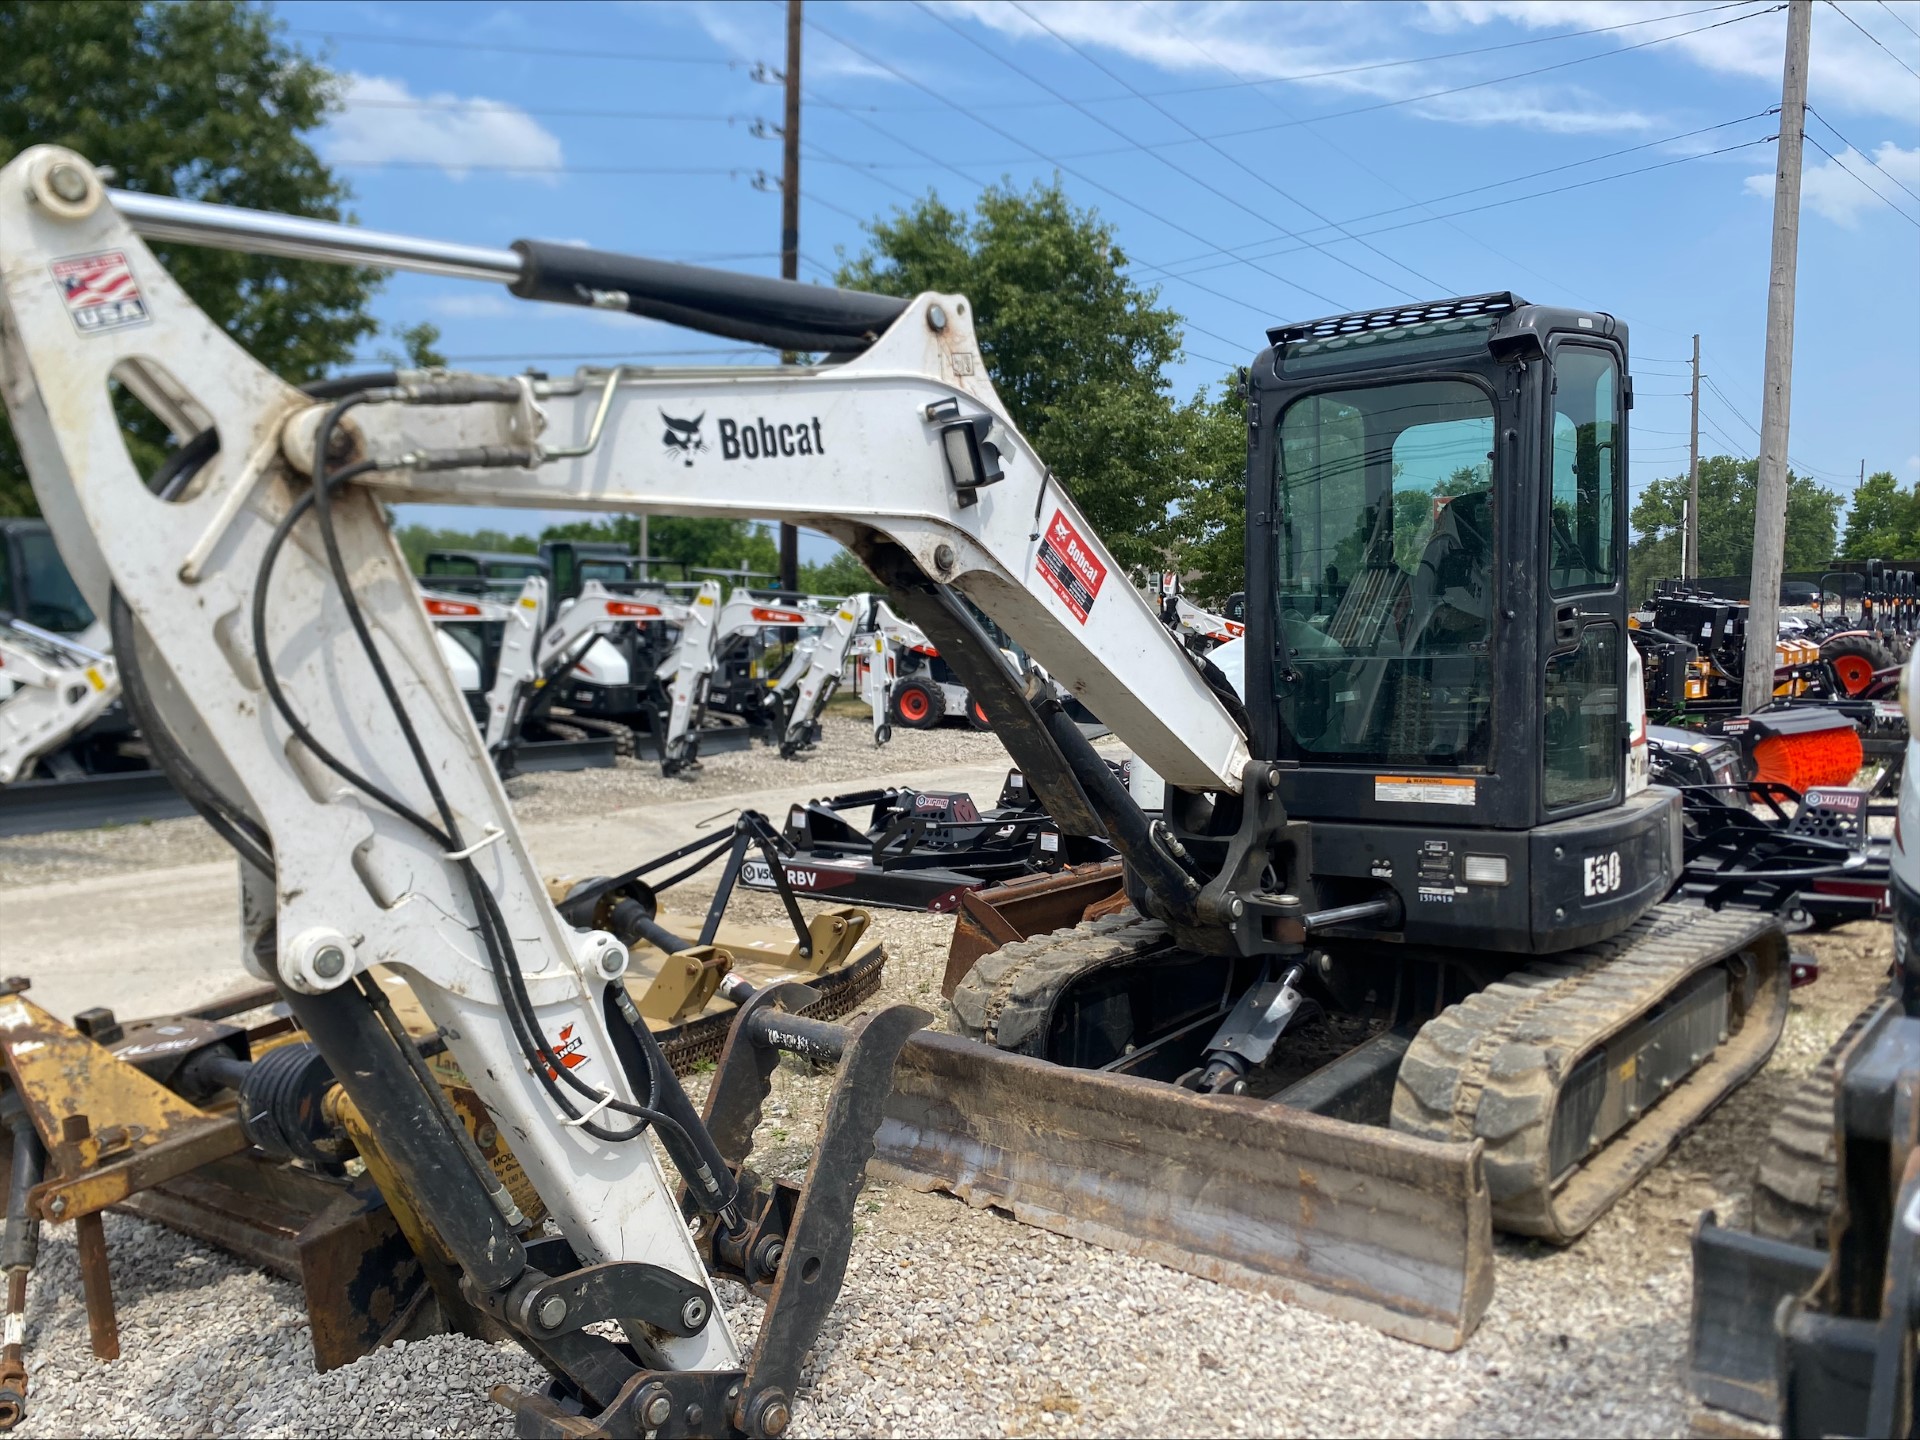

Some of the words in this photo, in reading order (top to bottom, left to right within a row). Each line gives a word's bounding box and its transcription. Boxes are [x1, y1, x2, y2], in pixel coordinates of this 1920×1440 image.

[75, 302, 142, 325] USA
[718, 416, 825, 461] Bobcat
[1067, 539, 1098, 586] Bobcat
[787, 865, 817, 887] RBV
[1584, 851, 1621, 897] E50
[436, 1053, 460, 1073] Lan
